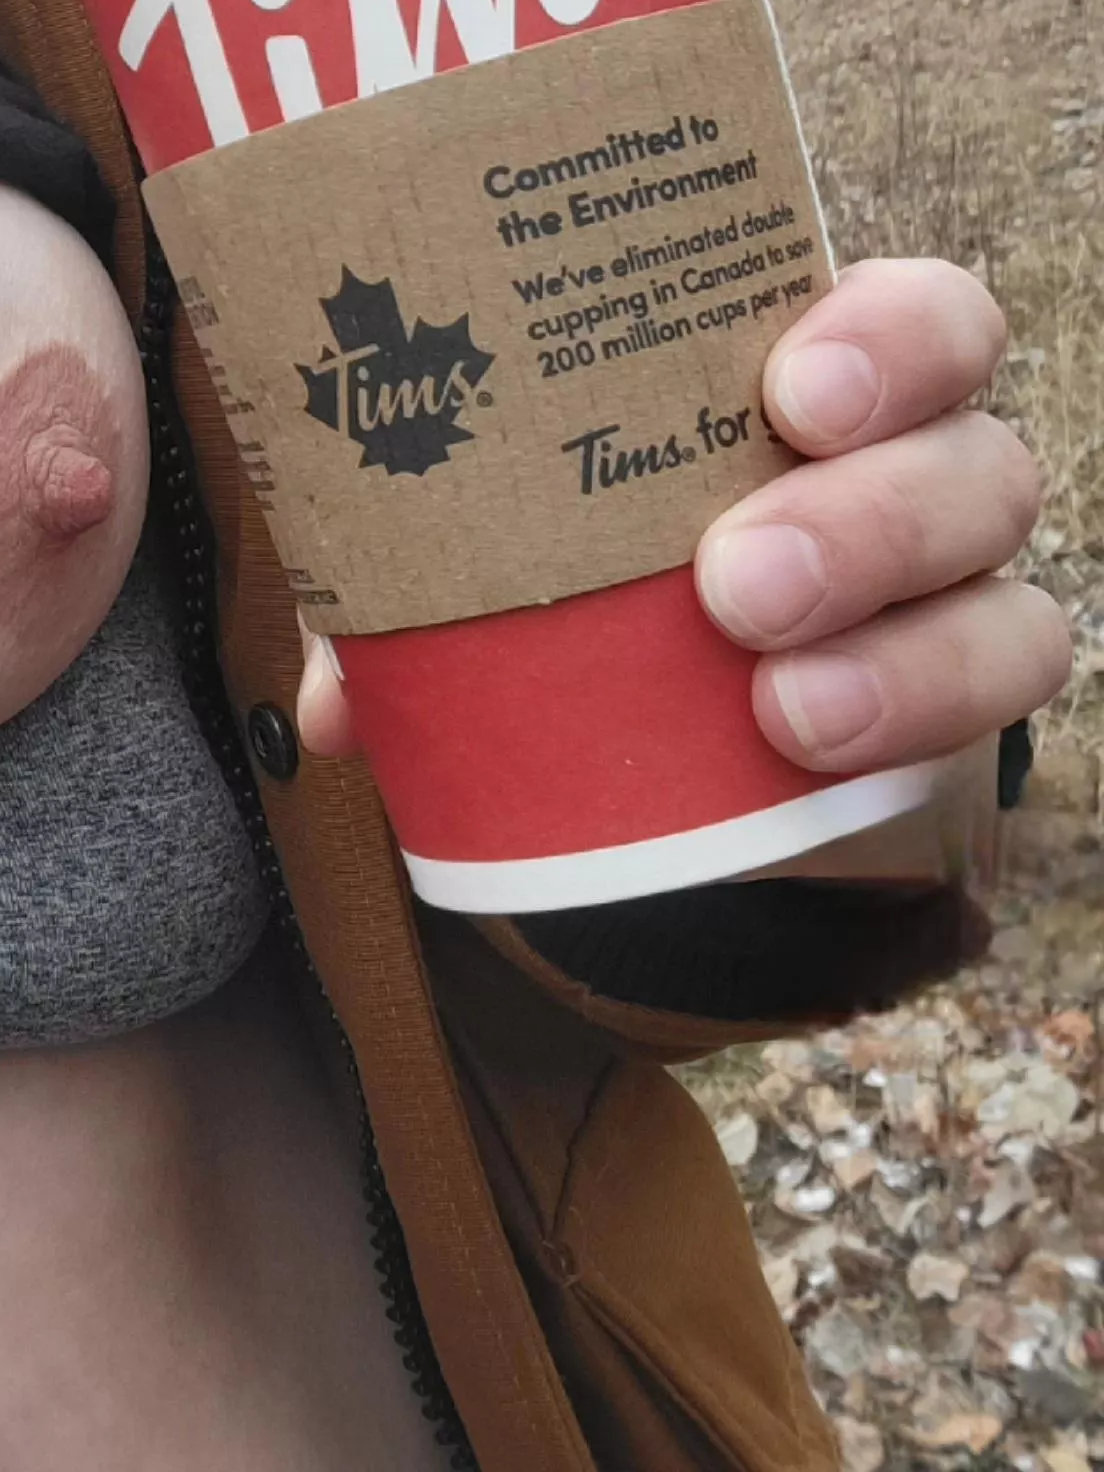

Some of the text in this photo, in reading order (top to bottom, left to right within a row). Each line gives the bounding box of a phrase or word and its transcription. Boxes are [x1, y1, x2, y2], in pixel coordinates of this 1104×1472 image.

[483, 115, 719, 199] Committed to
[498, 149, 758, 247] the Environment
[512, 199, 795, 304] We've eliminated double
[527, 291, 647, 341] cupping
[653, 279, 678, 305] in
[680, 249, 766, 294] Canada
[766, 245, 785, 266] to
[537, 274, 813, 378] 200 million cups per year
[312, 343, 476, 438] Tims
[561, 424, 682, 495] Tims
[697, 406, 751, 454] for
